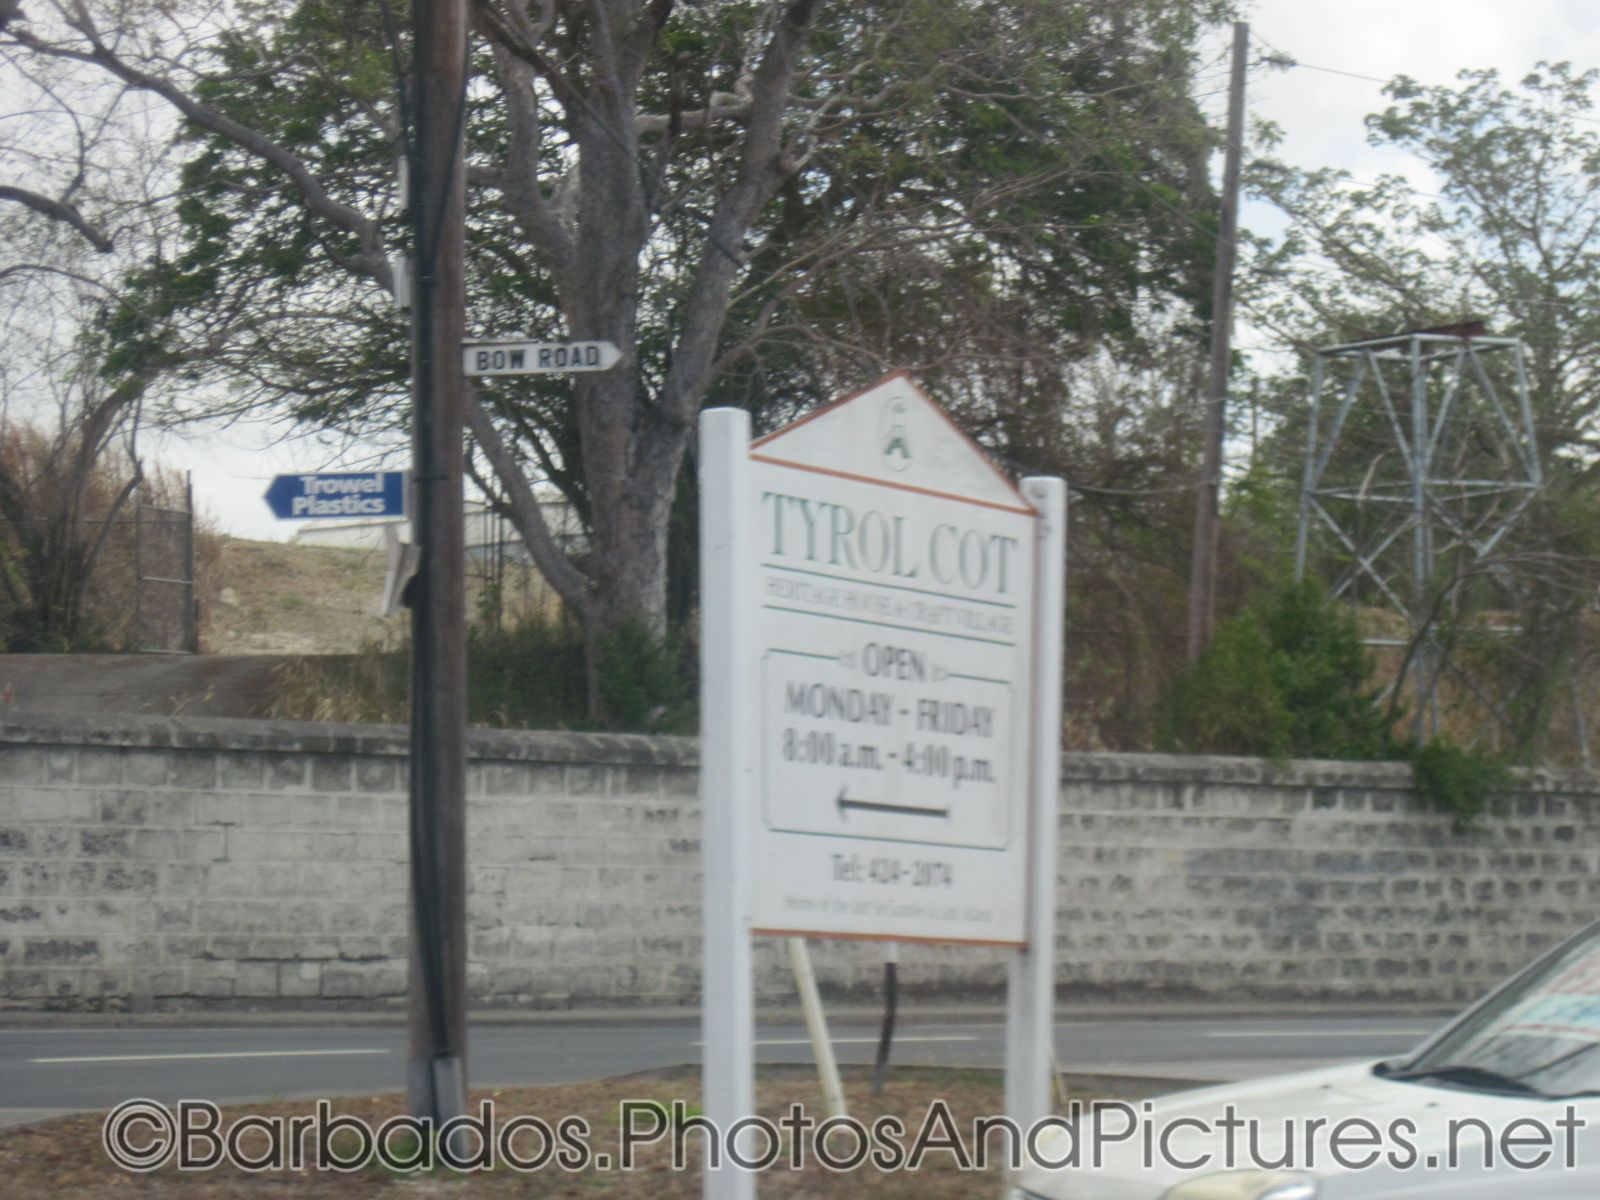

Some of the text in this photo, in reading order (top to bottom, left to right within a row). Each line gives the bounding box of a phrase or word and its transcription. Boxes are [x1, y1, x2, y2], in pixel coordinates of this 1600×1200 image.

[477, 346, 600, 371] BOW ROAD
[301, 474, 385, 495] Trowel
[292, 495, 386, 515] Plastics
[761, 491, 1018, 594] TYROL COT
[863, 642, 926, 683] OPEN
[784, 681, 893, 726] MONDAY
[917, 698, 993, 738] FRIDAY
[831, 853, 863, 882] Tel:
